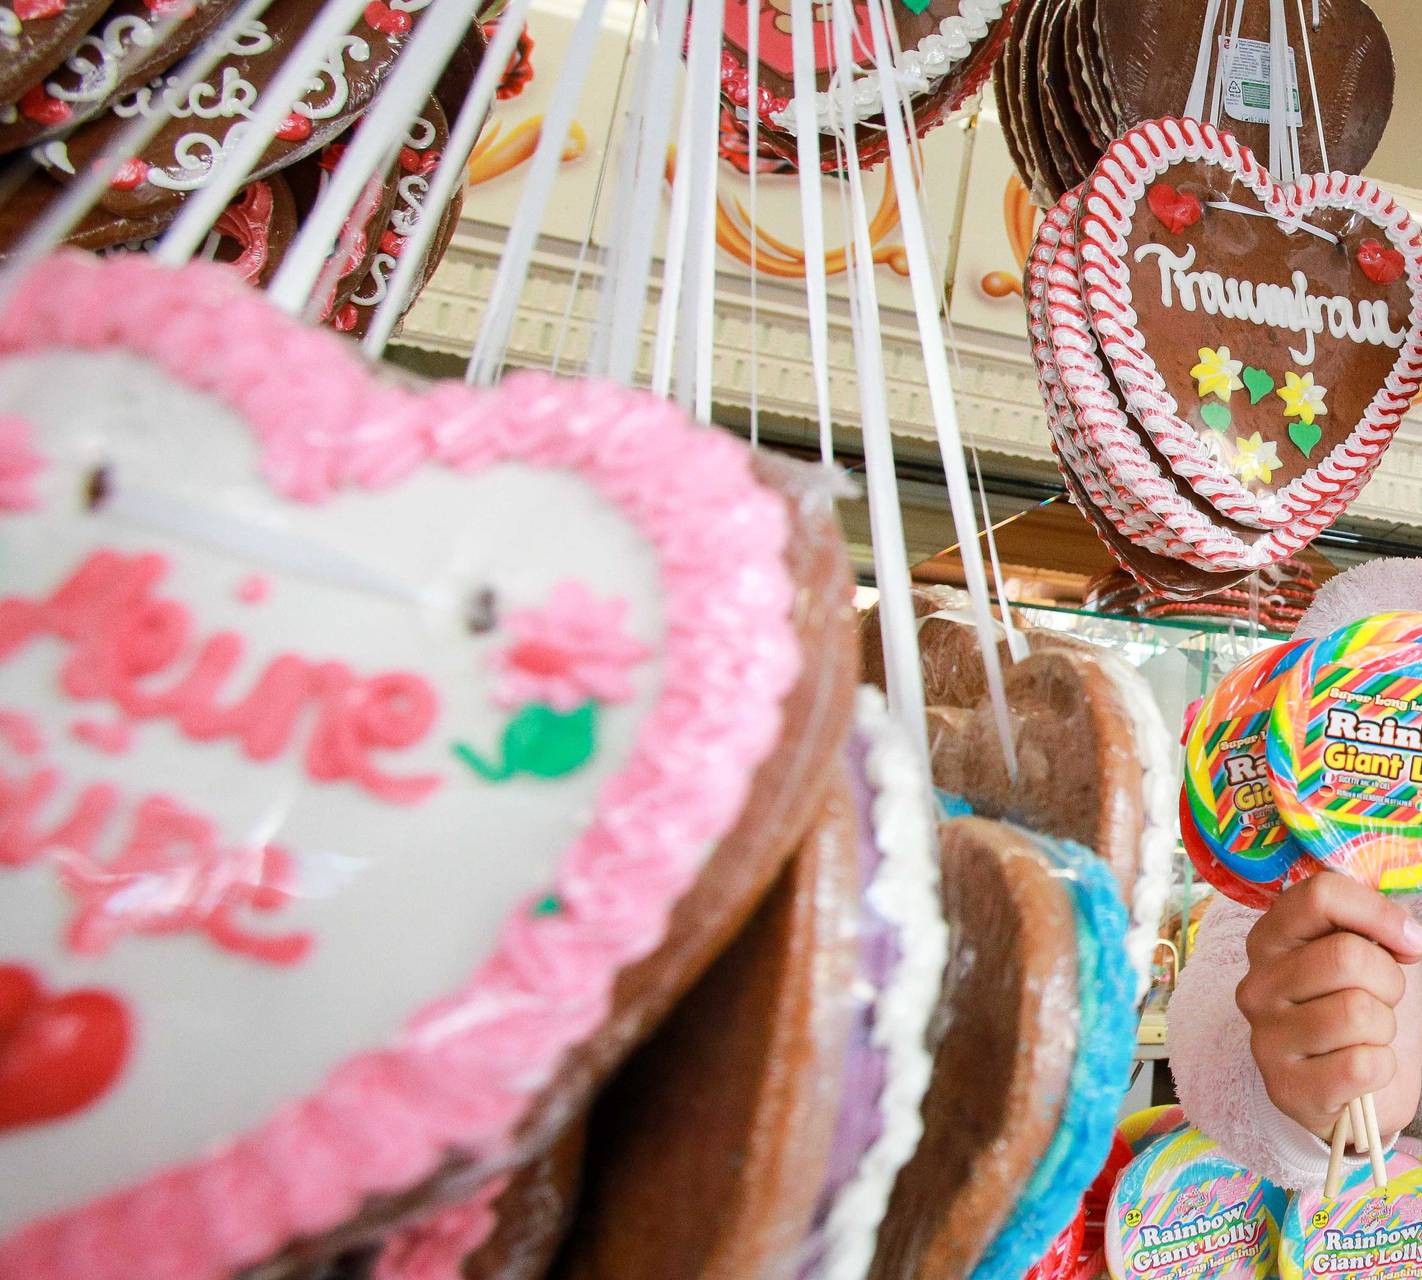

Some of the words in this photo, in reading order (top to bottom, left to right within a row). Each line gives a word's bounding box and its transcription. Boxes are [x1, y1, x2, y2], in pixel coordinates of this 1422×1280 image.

[1134, 243, 1406, 366] Traumfrau
[1330, 688, 1372, 703] Super
[1375, 695, 1409, 711] Long
[1324, 742, 1404, 780] Giant
[1127, 1213, 1141, 1222] 3+
[1142, 1205, 1244, 1248] Rainbow
[1315, 1214, 1328, 1222] 3+
[1133, 1243, 1199, 1272] Giant
[1204, 1221, 1258, 1252] Lolly
[1326, 1225, 1422, 1251] Rainbow
[1179, 1262, 1207, 1277] Long
[1313, 1252, 1374, 1274] Giant
